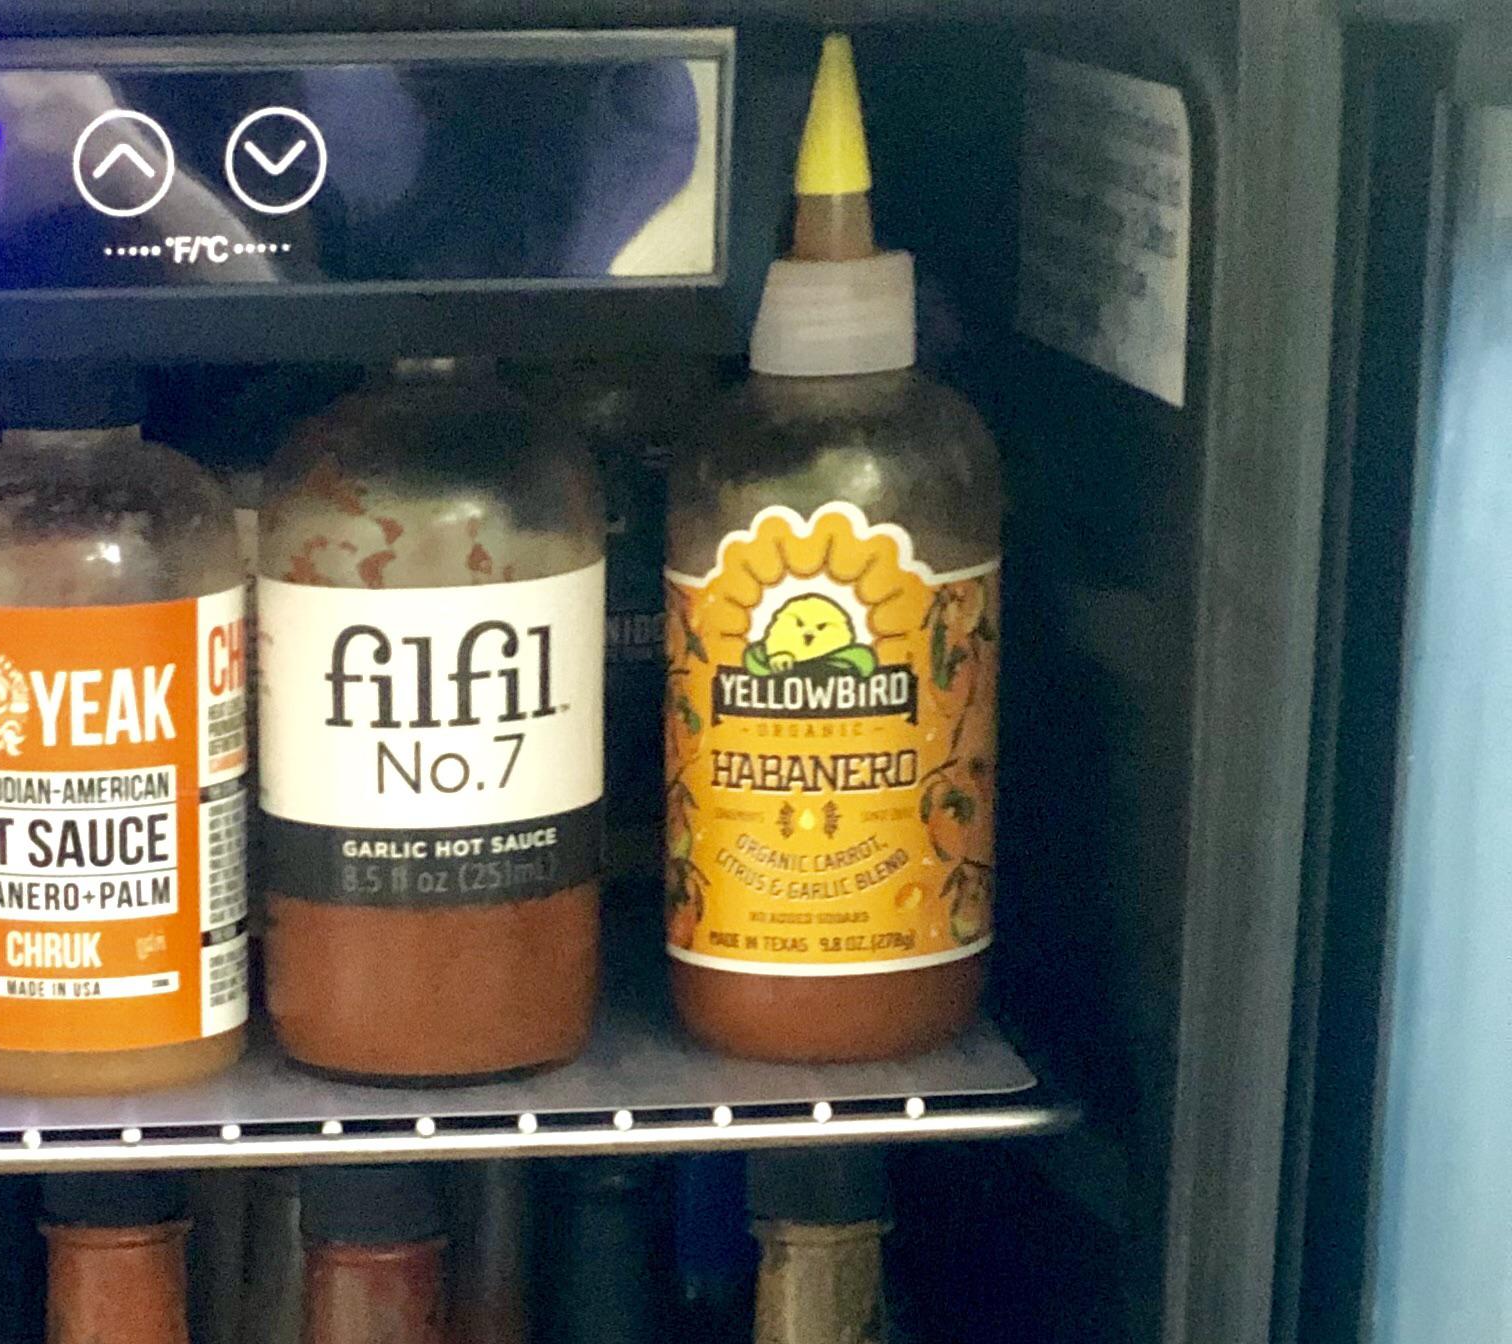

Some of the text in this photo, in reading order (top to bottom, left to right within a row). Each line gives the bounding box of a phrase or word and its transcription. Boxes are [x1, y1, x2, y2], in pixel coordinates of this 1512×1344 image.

[324, 620, 557, 729] filfil
[28, 663, 178, 748] YEAK
[757, 722, 864, 740] ORGANIC
[710, 748, 919, 794] HABANERO
[27, 812, 170, 869] SAUCE
[342, 827, 558, 860] GARLIC HOT SAUCE
[735, 833, 809, 875] ORGANIC
[417, 871, 448, 894] oz
[715, 848, 910, 901] CITRUS & GARLIC BLEND
[6, 929, 104, 969] CHRUK
[761, 937, 808, 953] TEXAS
[7, 978, 102, 998] MADE IN USA
